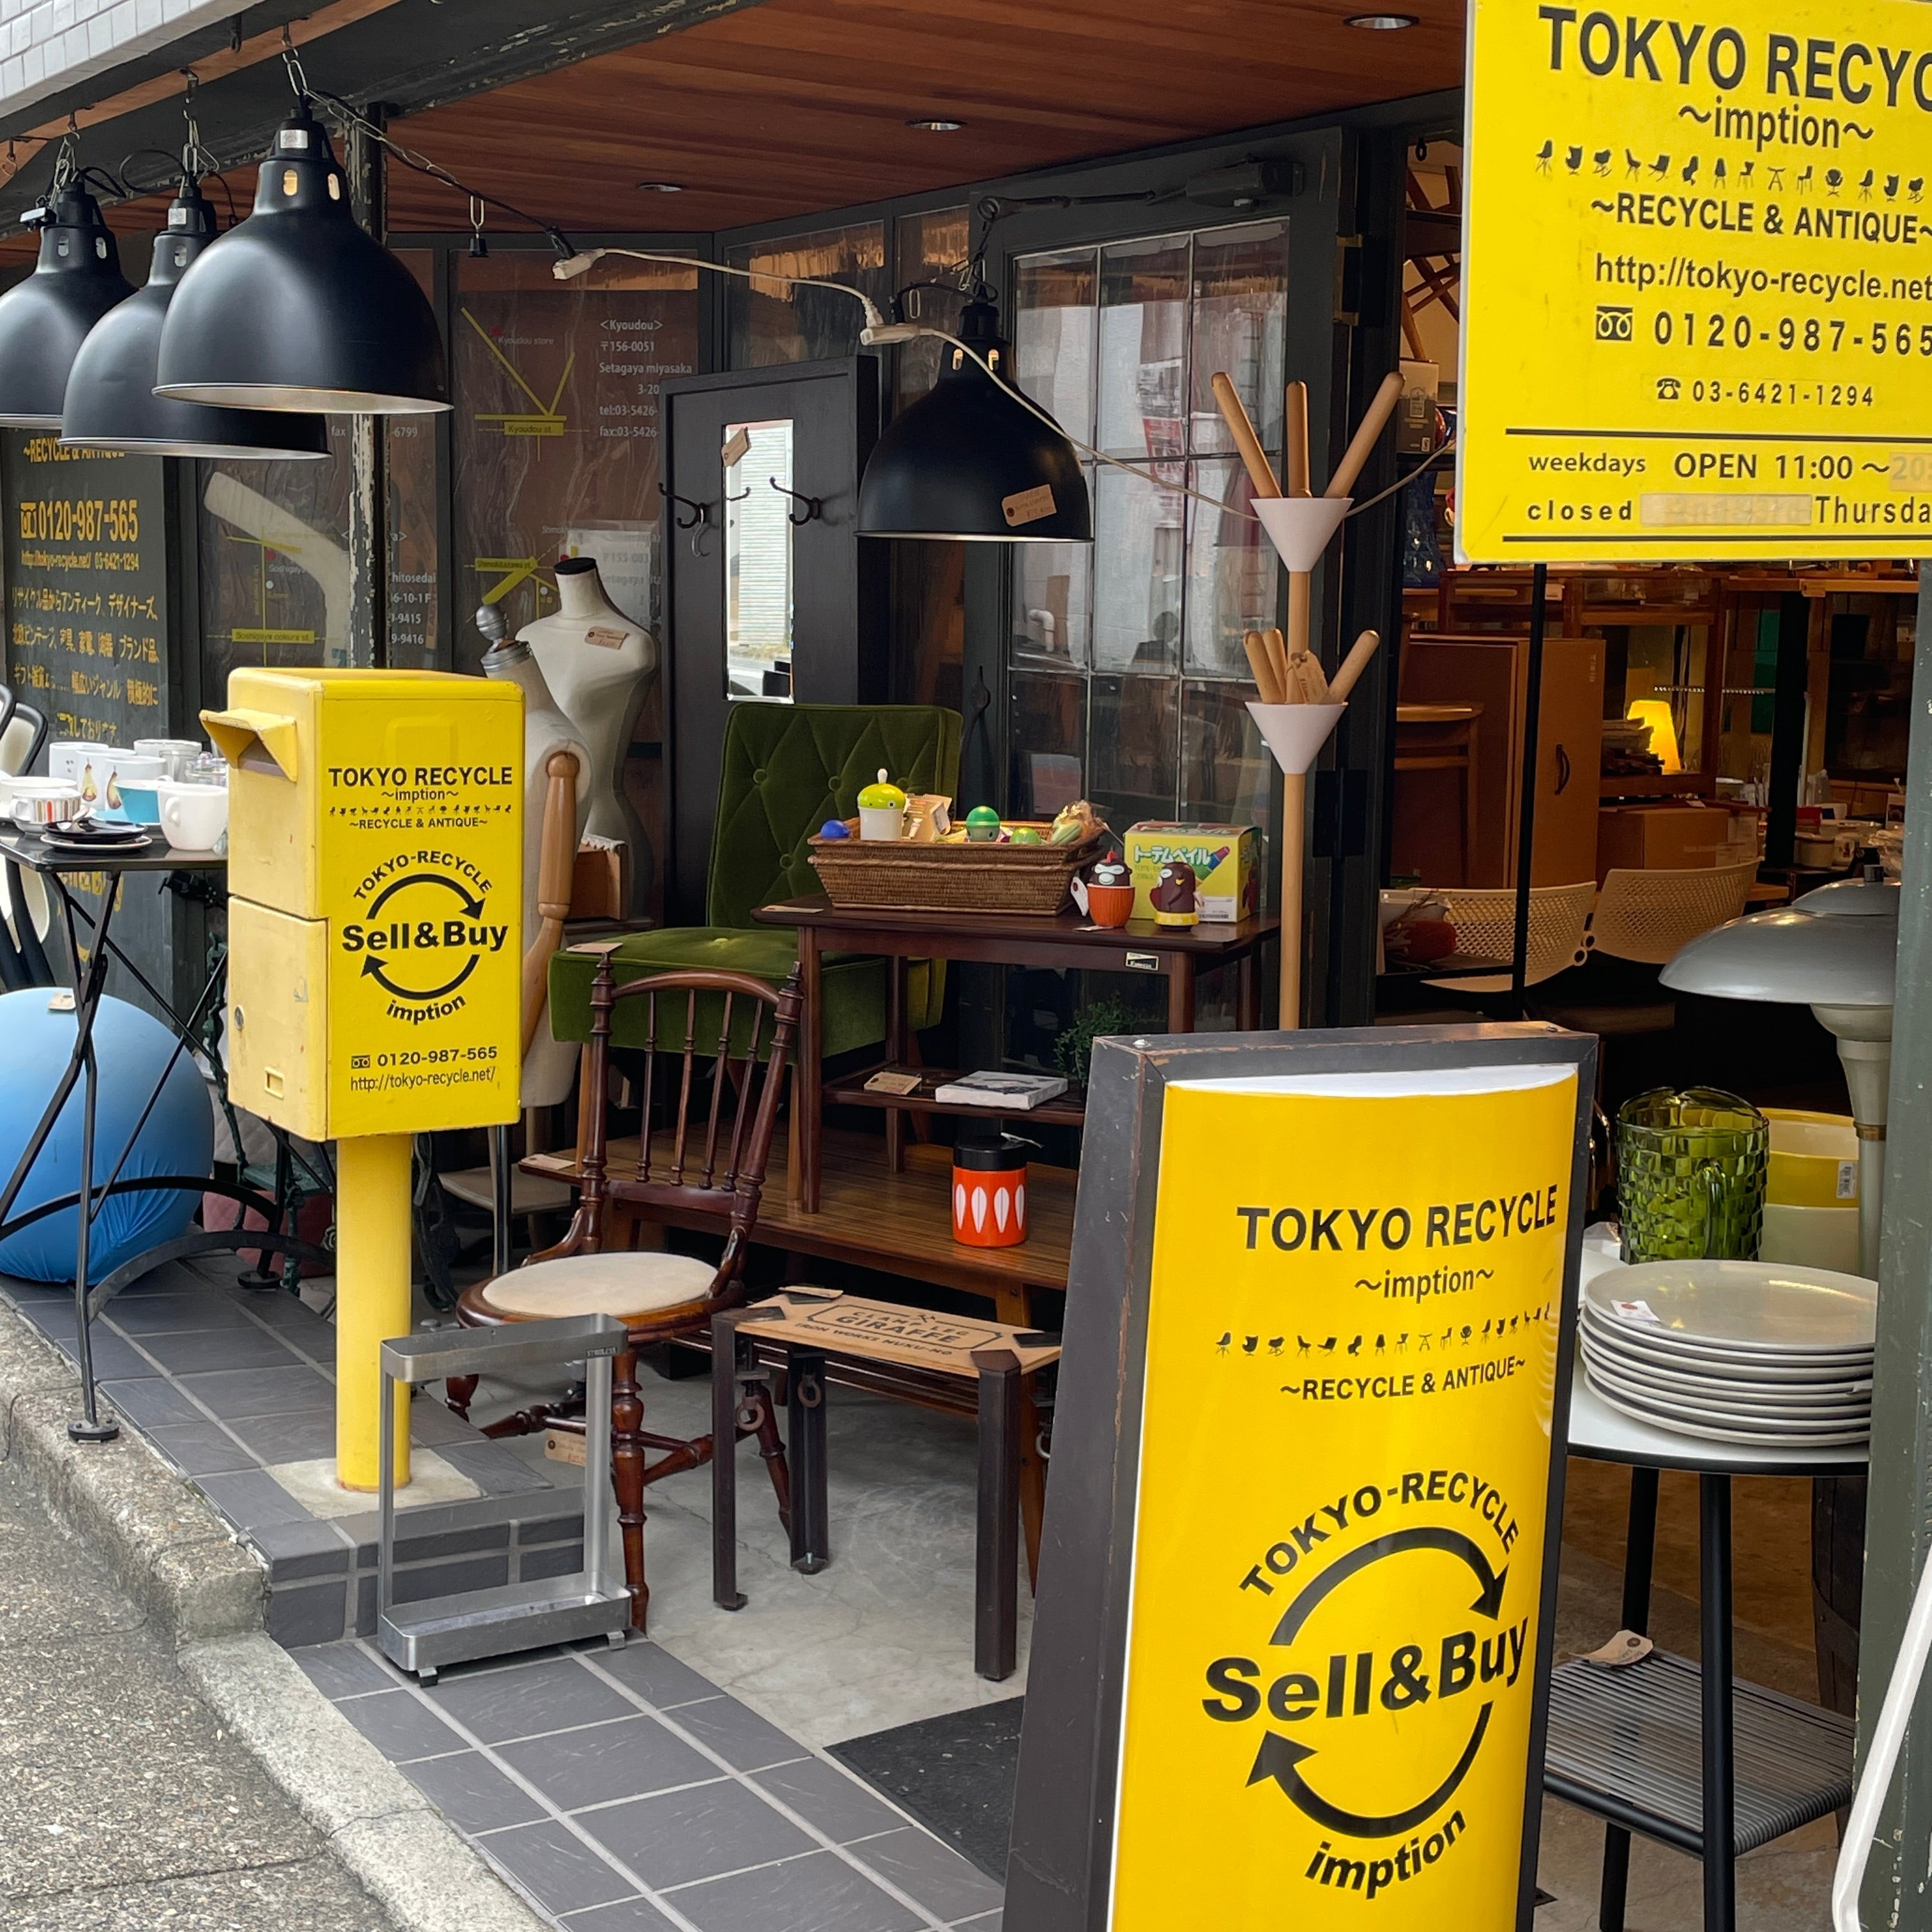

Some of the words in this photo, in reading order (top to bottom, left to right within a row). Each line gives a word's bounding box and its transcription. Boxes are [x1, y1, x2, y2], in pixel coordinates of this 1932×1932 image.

[1538, 5, 1745, 91] TOKYO
[1764, 208, 1783, 234] &
[533, 337, 555, 345] store
[1654, 310, 1932, 356] 0120-987-565
[599, 362, 644, 375] Setagaya
[647, 363, 692, 375] miyasaka
[638, 385, 659, 394] 3-20
[1692, 380, 1874, 406] 03-6421-1294
[508, 425, 541, 434] Kyoudou
[1528, 452, 1646, 477] weekdays
[1674, 453, 1758, 479] OPEN
[1775, 455, 1853, 480] 11:00
[37, 499, 139, 542] 0120-987-565
[1527, 500, 1633, 522] closed
[1814, 496, 1932, 524] Thursda
[328, 767, 407, 786] TOKYO
[415, 767, 512, 786] RECYCLE
[416, 819, 424, 828] &
[1134, 844, 1211, 865] トーテムペイル
[353, 850, 493, 901] TOKYO-RECYCLE
[342, 921, 509, 952] Sell&Buy
[386, 995, 466, 1025] imption
[378, 1046, 497, 1066] 0120-987-565
[351, 1066, 496, 1092] http://tokyo-recycle.net/
[1236, 1206, 1411, 1251] TOKYO
[1425, 1184, 1558, 1248] RECYCLE
[795, 1323, 830, 1332] IRON
[834, 1330, 880, 1342] WORKS
[836, 1316, 960, 1343] GIRAFFE
[1421, 1372, 1436, 1393] &
[1239, 1469, 1519, 1597] TOKYO-RECYCLE
[1201, 1616, 1528, 1722] Sell&Buy
[1305, 1809, 1467, 1900] imption
